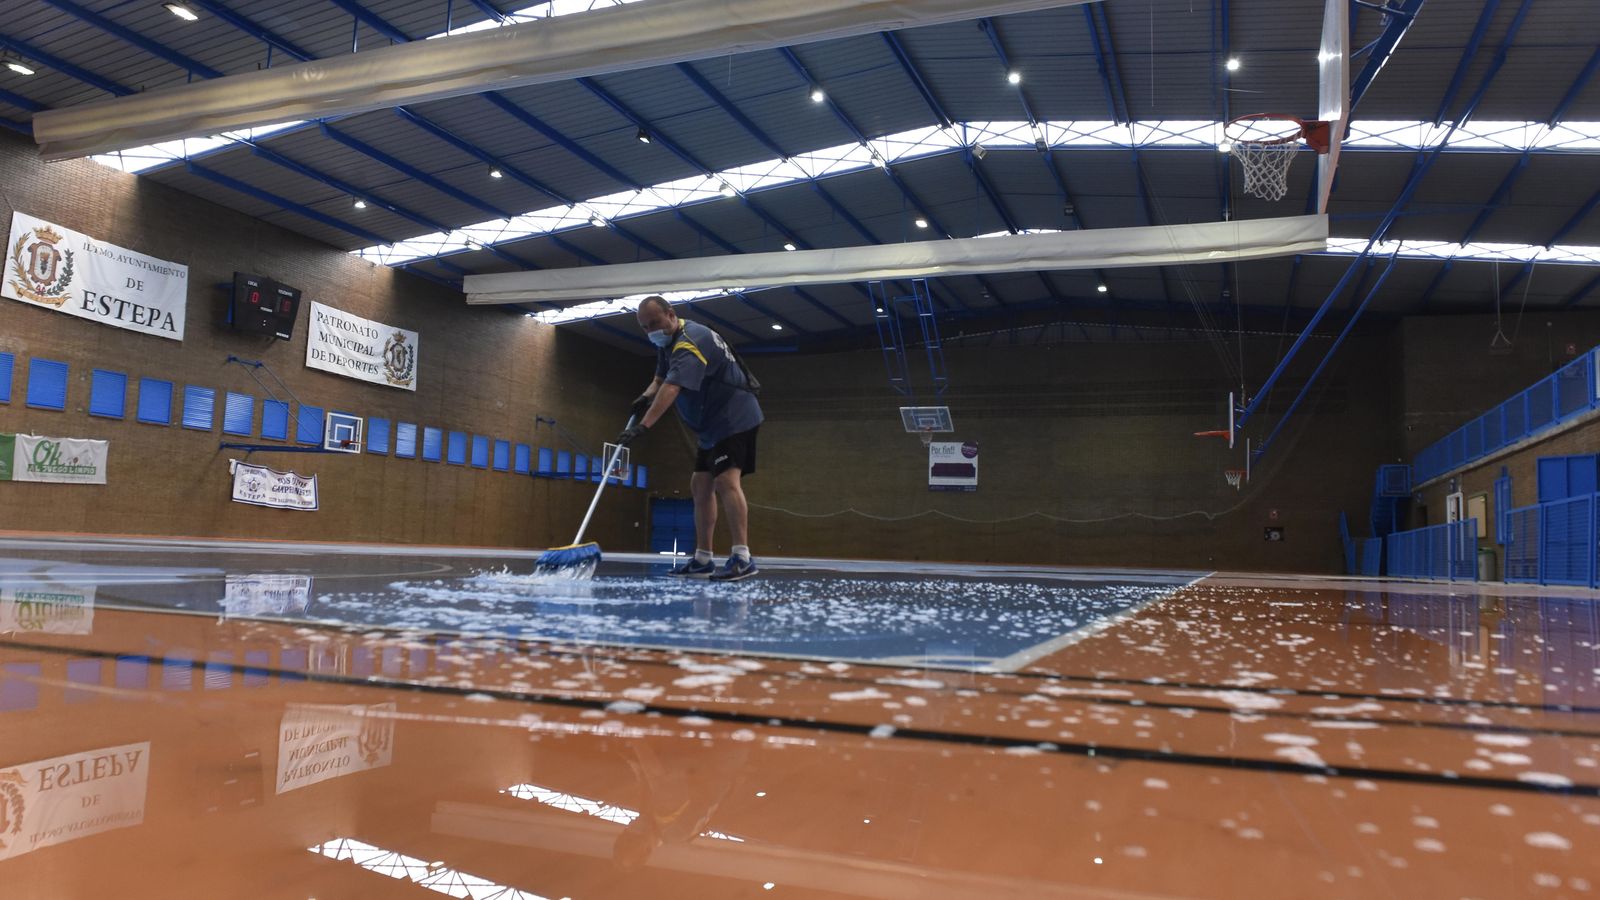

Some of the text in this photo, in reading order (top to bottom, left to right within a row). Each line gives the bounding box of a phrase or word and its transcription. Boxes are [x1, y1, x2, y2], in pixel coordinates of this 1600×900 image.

[116, 254, 186, 279] AYUNTAMIENTO
[125, 277, 144, 291] DE
[80, 289, 177, 332] ESTEPA
[317, 311, 379, 339] PATRONATO
[318, 331, 375, 356] MUNICIPAL
[311, 348, 379, 375] DE DEPORTES
